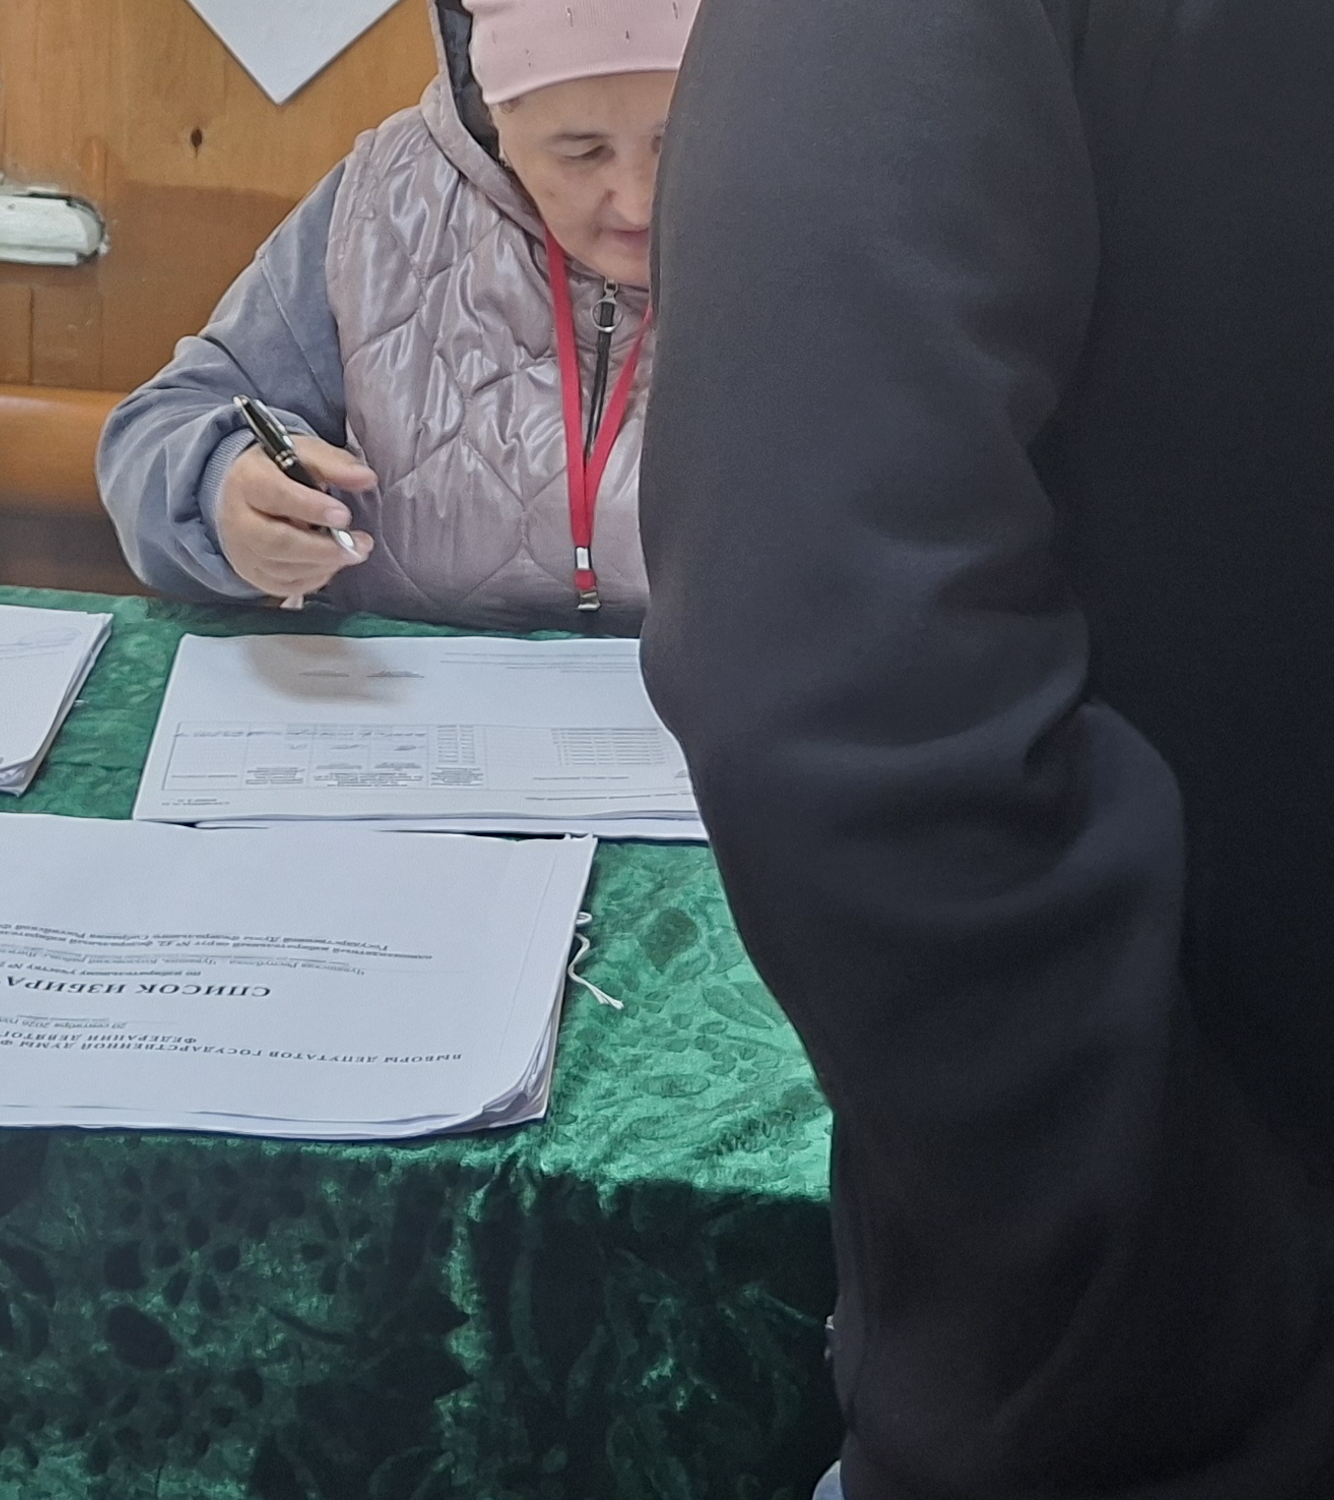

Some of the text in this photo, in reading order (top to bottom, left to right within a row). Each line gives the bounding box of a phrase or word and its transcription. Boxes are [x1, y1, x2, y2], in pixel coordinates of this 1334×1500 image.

[135, 983, 271, 998] СПИСОК
[87, 1034, 197, 1044] ФЕДЕРАЦИИ
[19, 1041, 76, 1050] ДУМЫ
[81, 1042, 263, 1057] ГОСУДАРСТВЕННОЙ
[269, 1051, 378, 1063] ДЕПУТАТОВ
[384, 1053, 462, 1063] ВЫБОРЫ
